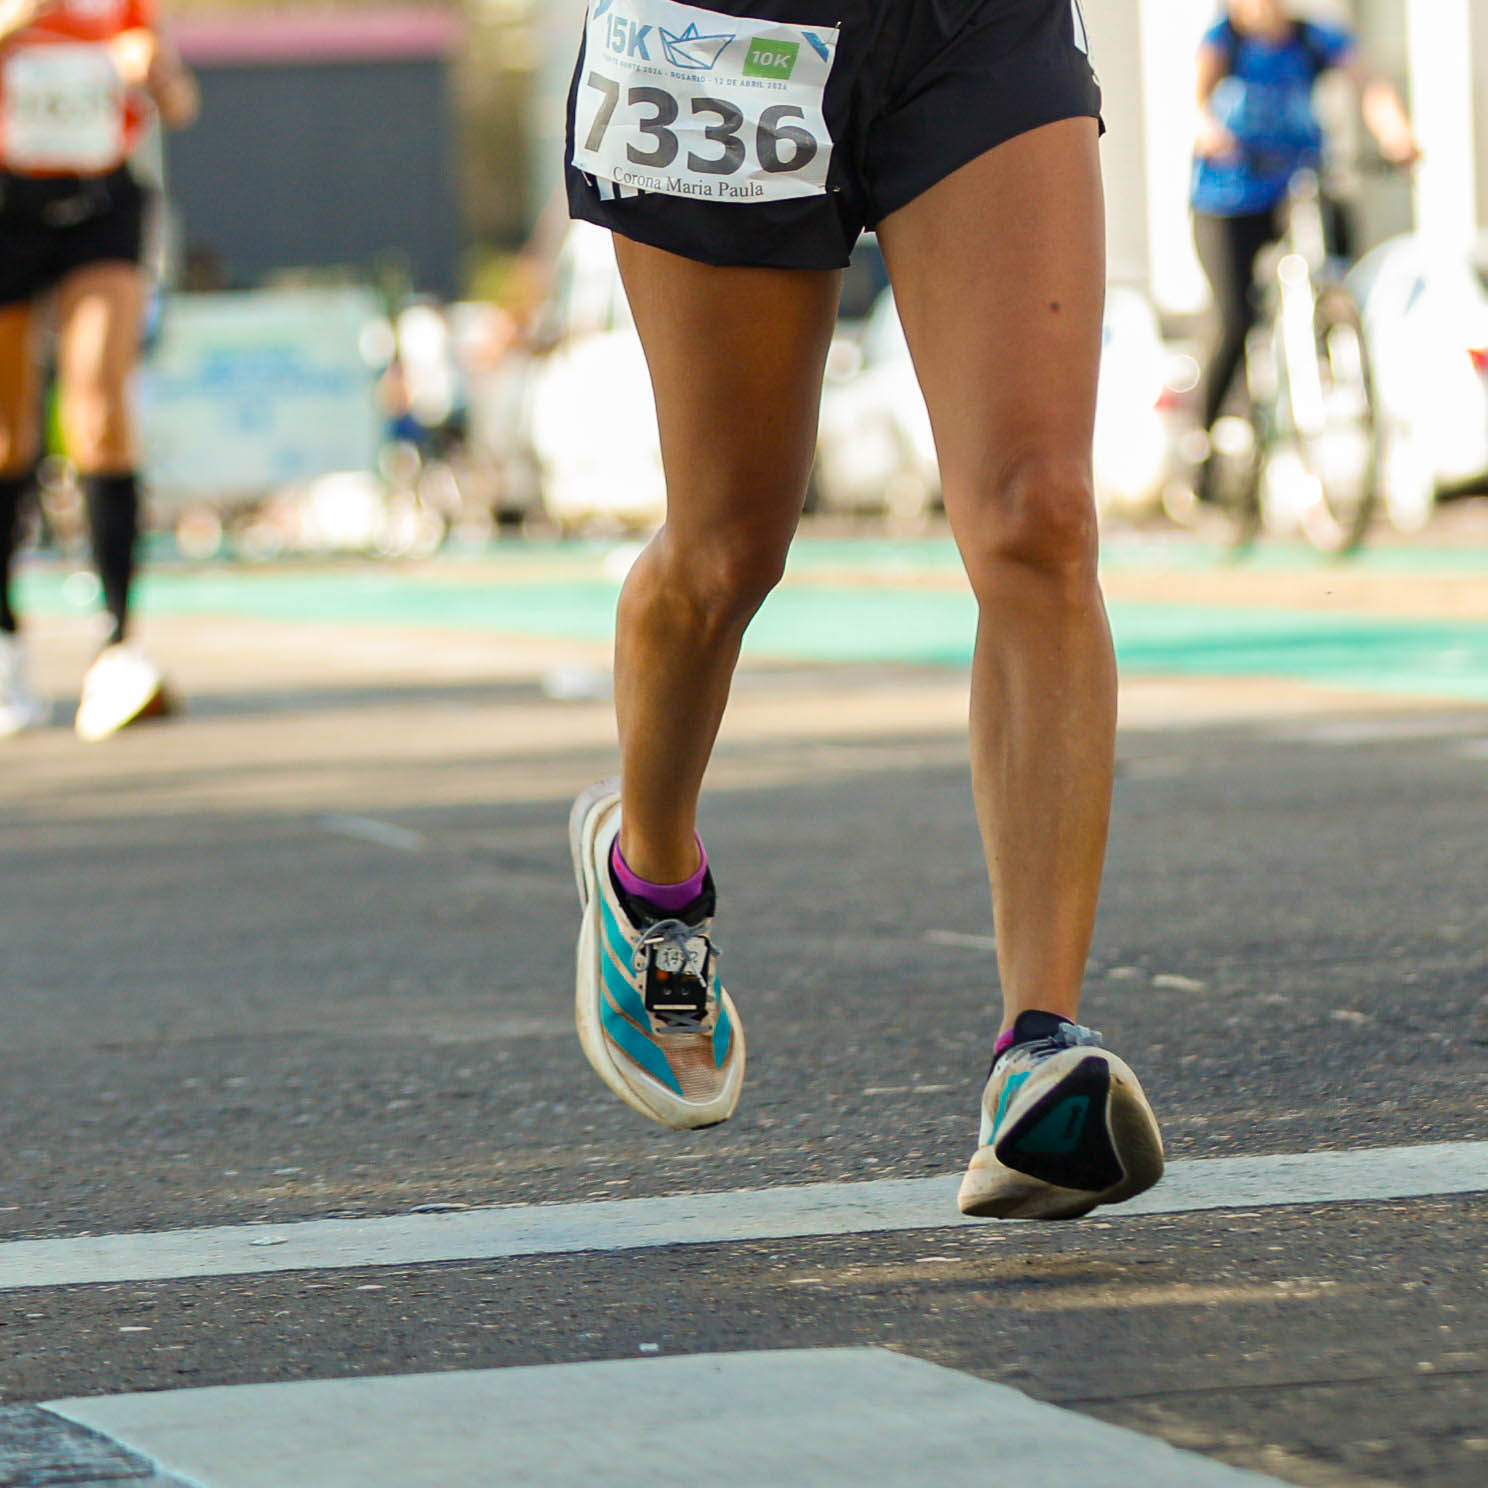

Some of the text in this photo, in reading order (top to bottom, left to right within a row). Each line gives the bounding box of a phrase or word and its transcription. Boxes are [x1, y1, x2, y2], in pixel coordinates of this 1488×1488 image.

[606, 13, 791, 69] 15K 10K
[740, 80, 764, 88] ABRIL
[584, 71, 818, 175] 7336
[612, 166, 764, 197] Corona Maria Paula
